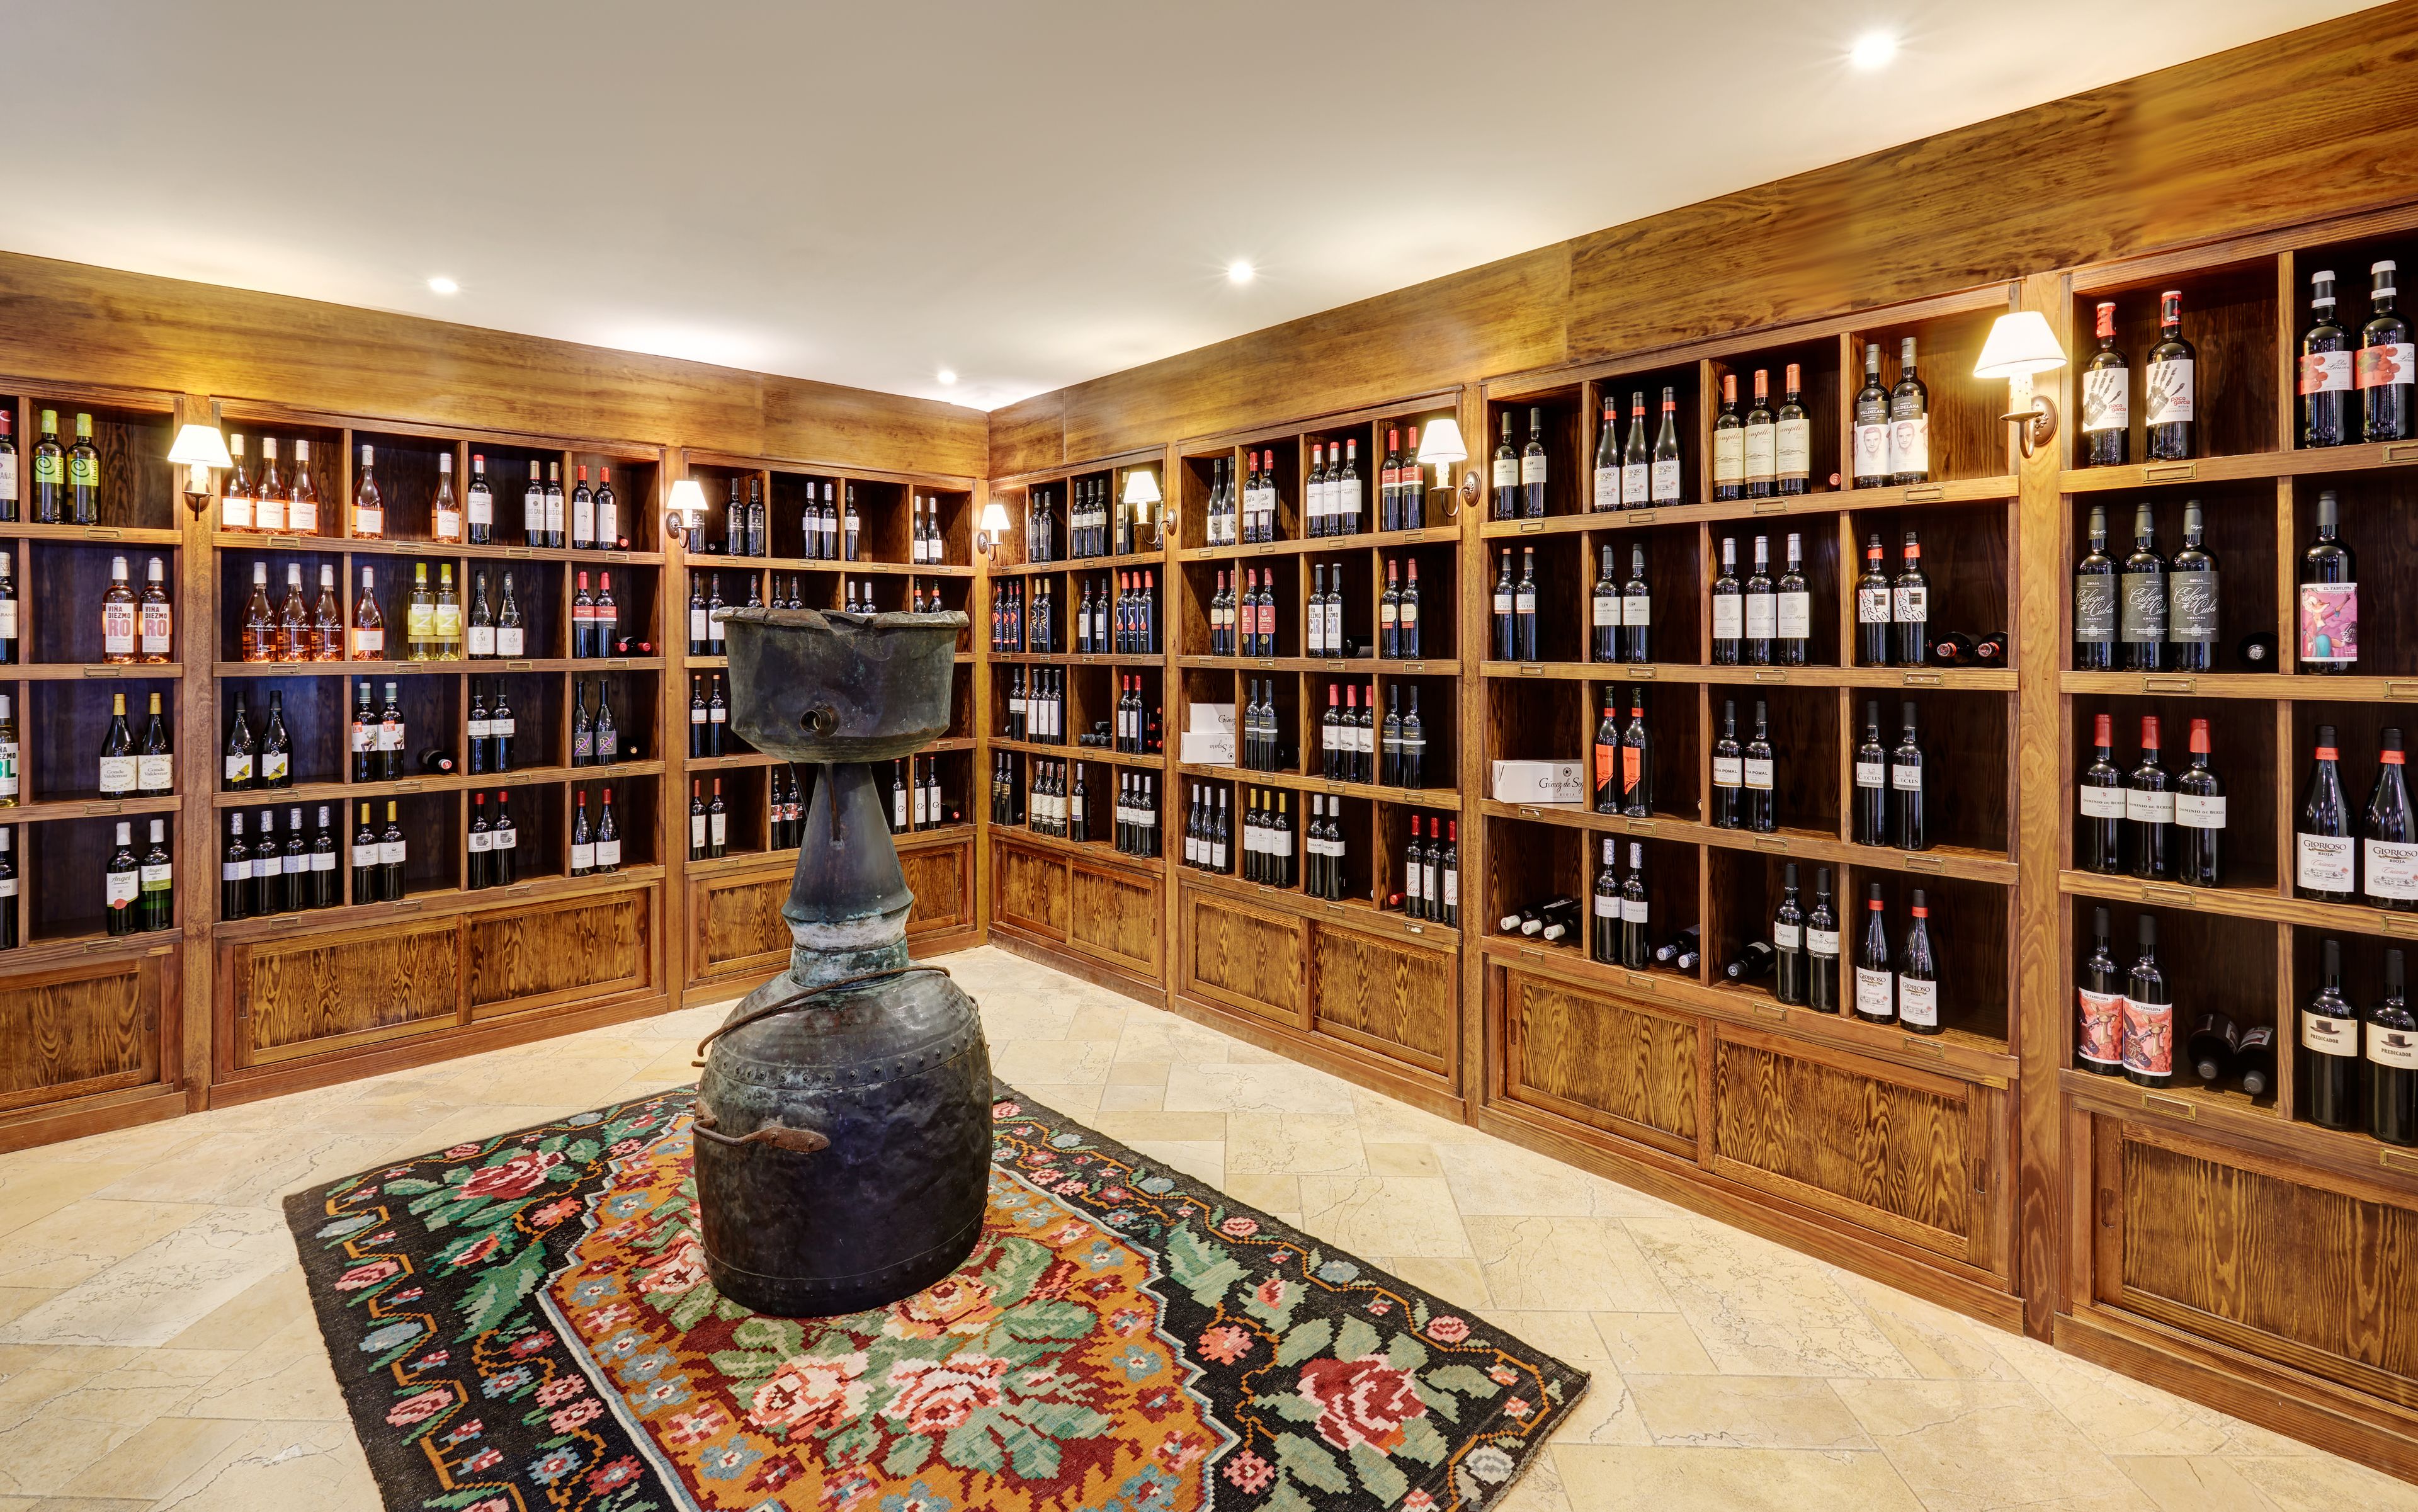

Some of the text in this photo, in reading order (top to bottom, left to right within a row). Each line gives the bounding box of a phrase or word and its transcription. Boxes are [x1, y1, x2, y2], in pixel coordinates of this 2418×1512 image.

[1715, 433, 1741, 443] Campillo
[2076, 589, 2105, 609] Cabeza
[2129, 588, 2163, 608] Cabeza
[2174, 586, 2209, 607] Cabeza
[2090, 600, 2115, 616] Cuba
[2193, 598, 2217, 615] Cuba
[108, 619, 130, 637] RO
[145, 619, 167, 637] RO
[1218, 715, 1235, 725] Gómez
[1210, 739, 1228, 753] Segura
[1858, 772, 1881, 780] CECUS
[1894, 775, 1918, 783] CECUS
[1539, 777, 1563, 793] Gómez
[1564, 778, 1571, 788] de
[2303, 839, 2346, 850] GLORIOSO
[2373, 847, 2417, 856] GLORIOSO
[2311, 859, 2337, 867] Crianza
[1859, 973, 1886, 982] GLORIOSO
[1903, 982, 1930, 992] GLORIOSO
[2310, 1033, 2339, 1043] PREDICADOR
[2381, 1048, 2412, 1057] PREDICADOR
